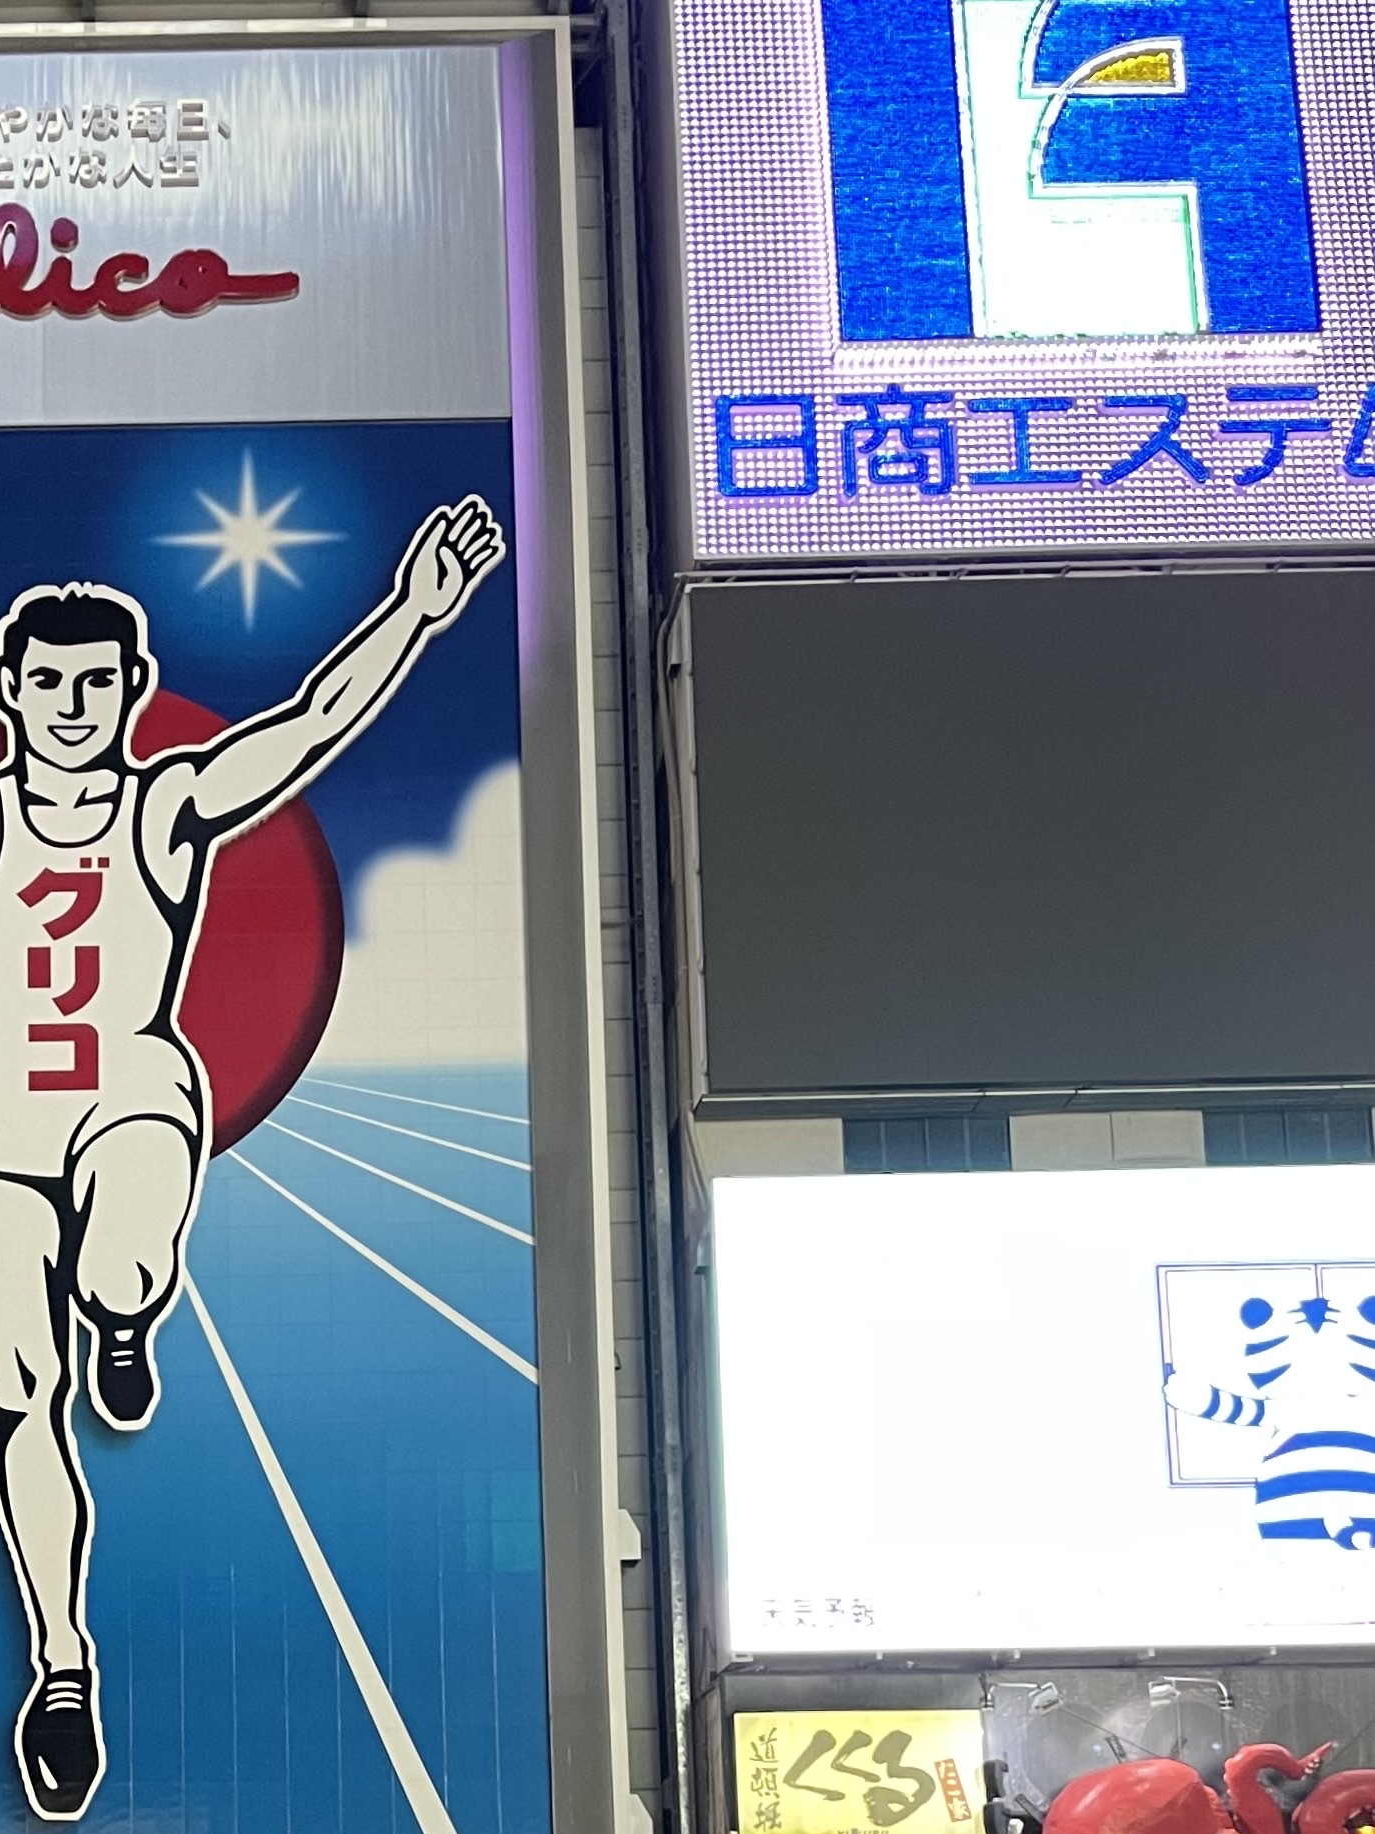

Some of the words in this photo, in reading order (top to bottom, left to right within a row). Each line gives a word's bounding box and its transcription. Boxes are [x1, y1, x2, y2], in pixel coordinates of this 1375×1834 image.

[717, 383, 1375, 497] 日商エステ
[16, 856, 110, 1092] グリコ
[749, 1727, 783, 1832] 道頓堀
[783, 1730, 936, 1827] くくる
